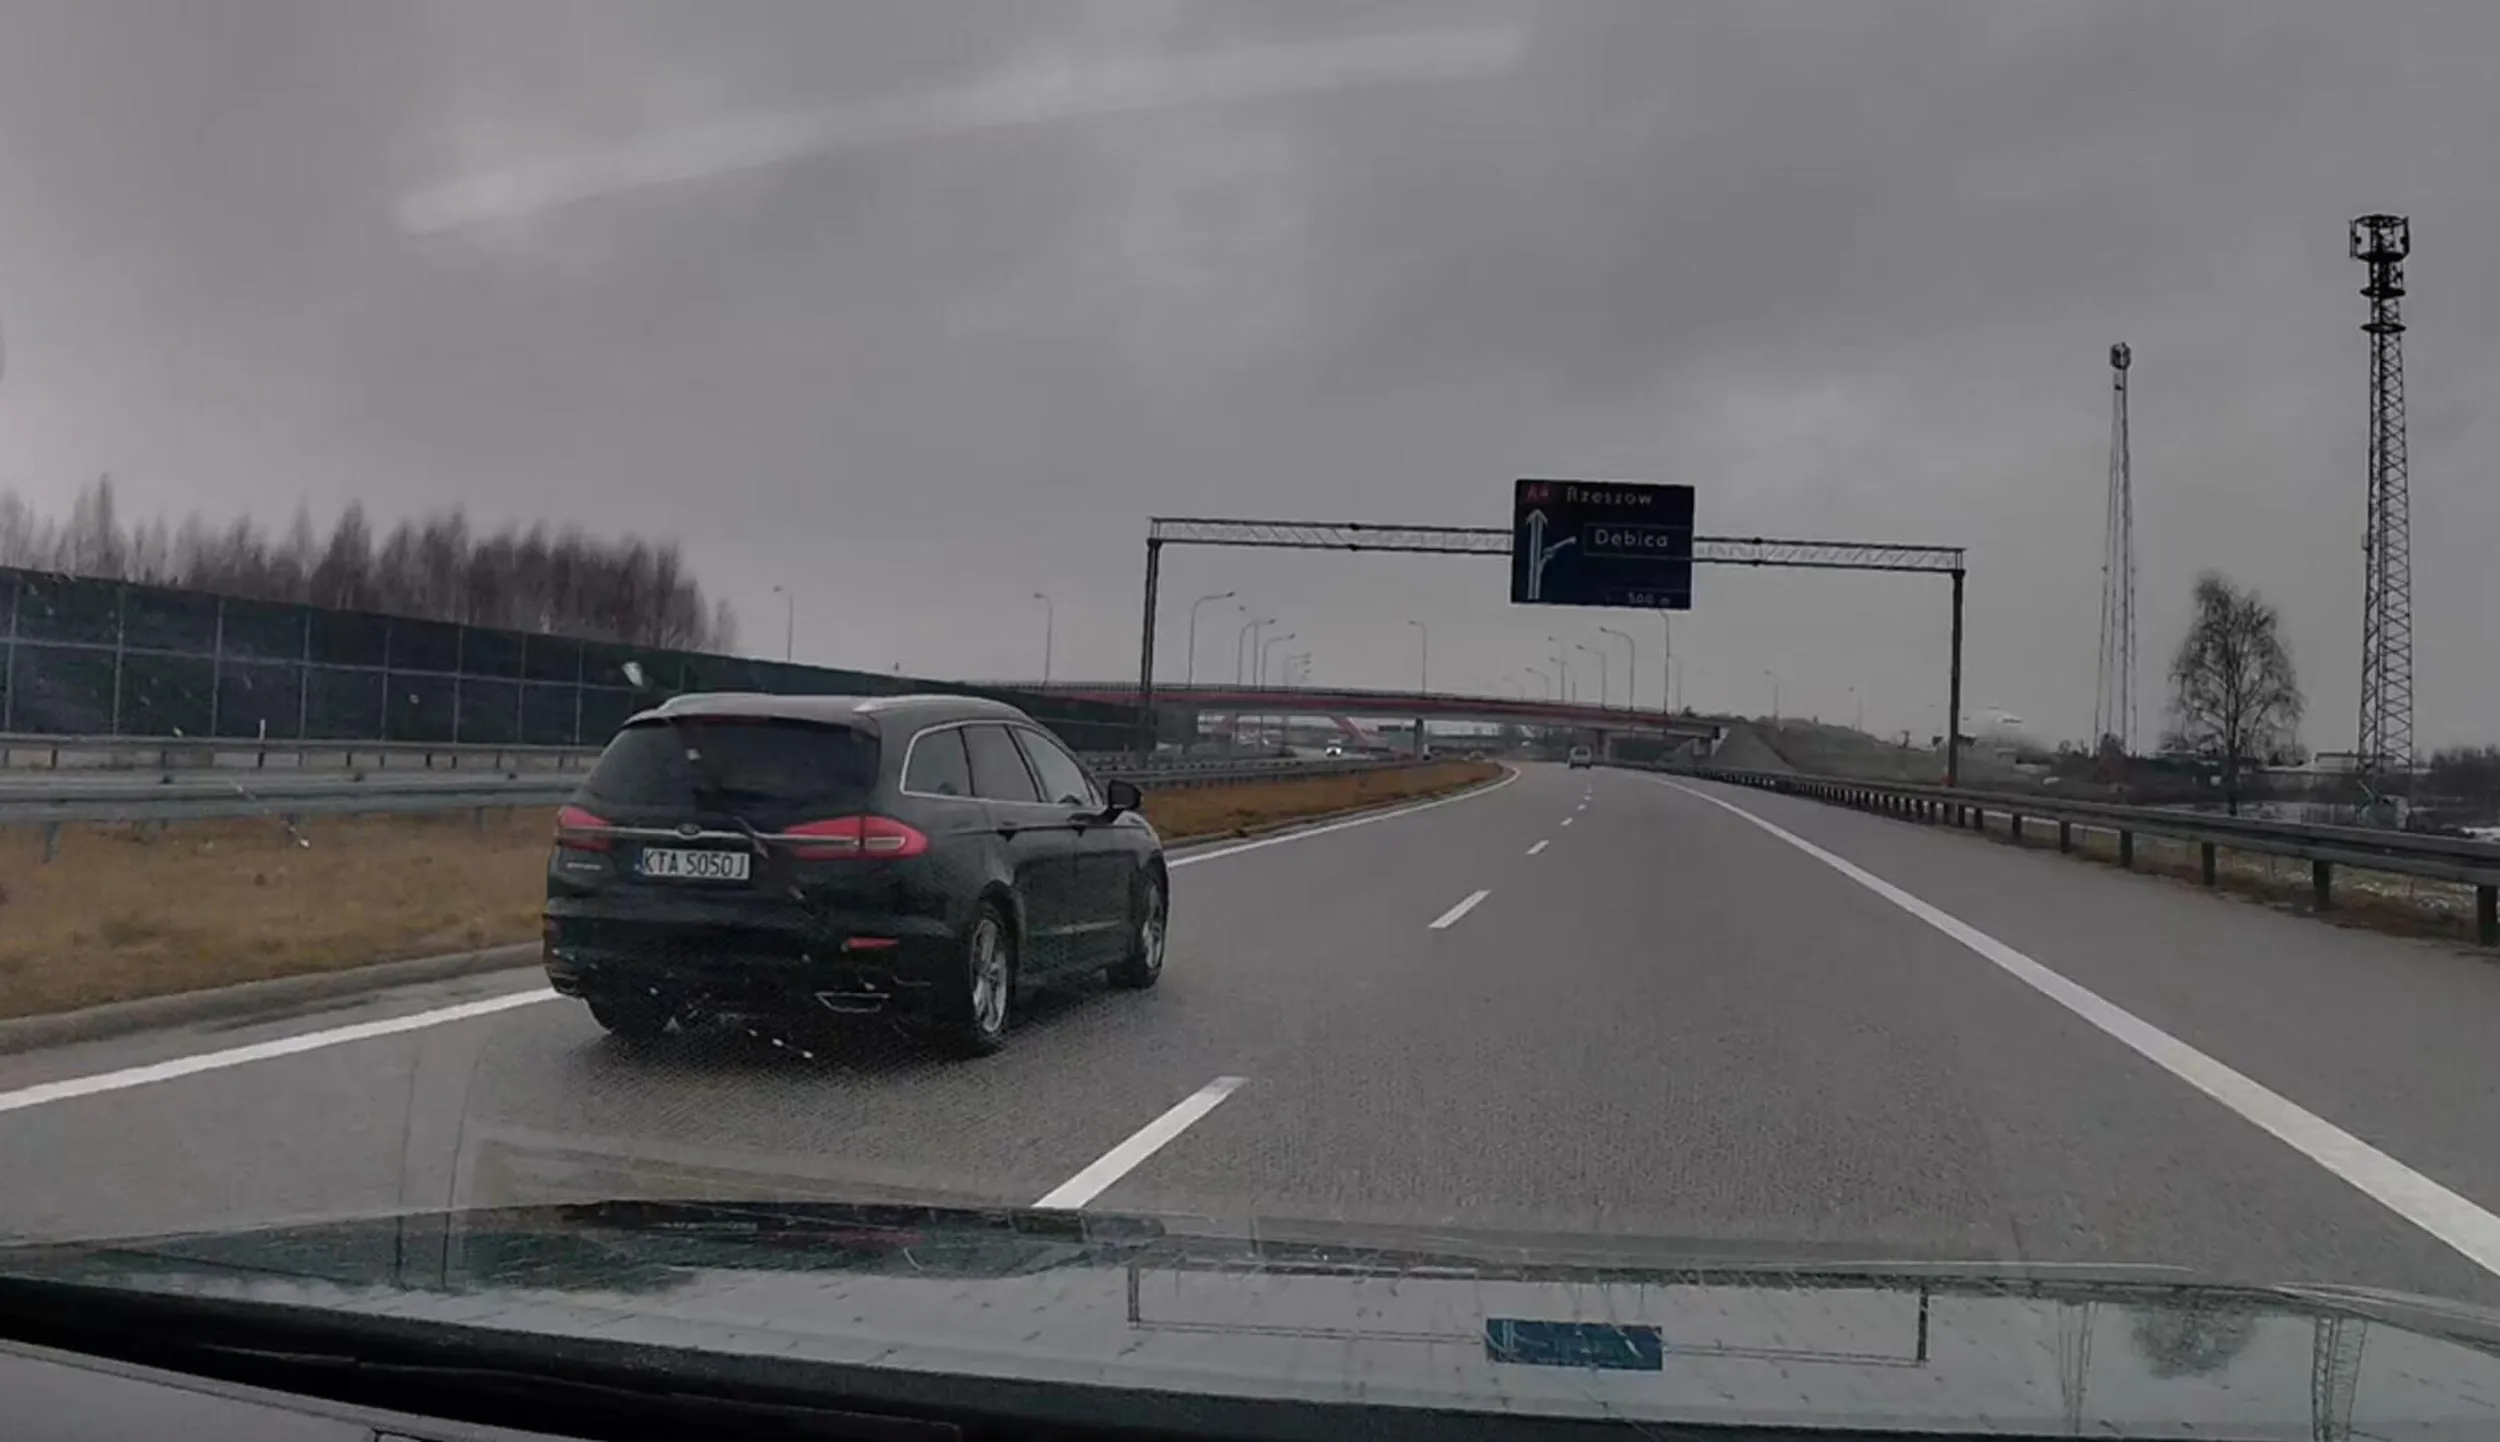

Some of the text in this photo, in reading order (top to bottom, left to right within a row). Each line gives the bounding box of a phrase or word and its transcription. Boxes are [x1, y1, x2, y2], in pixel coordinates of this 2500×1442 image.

[1527, 484, 1550, 501] A4
[645, 850, 746, 877] KTA 5050J
